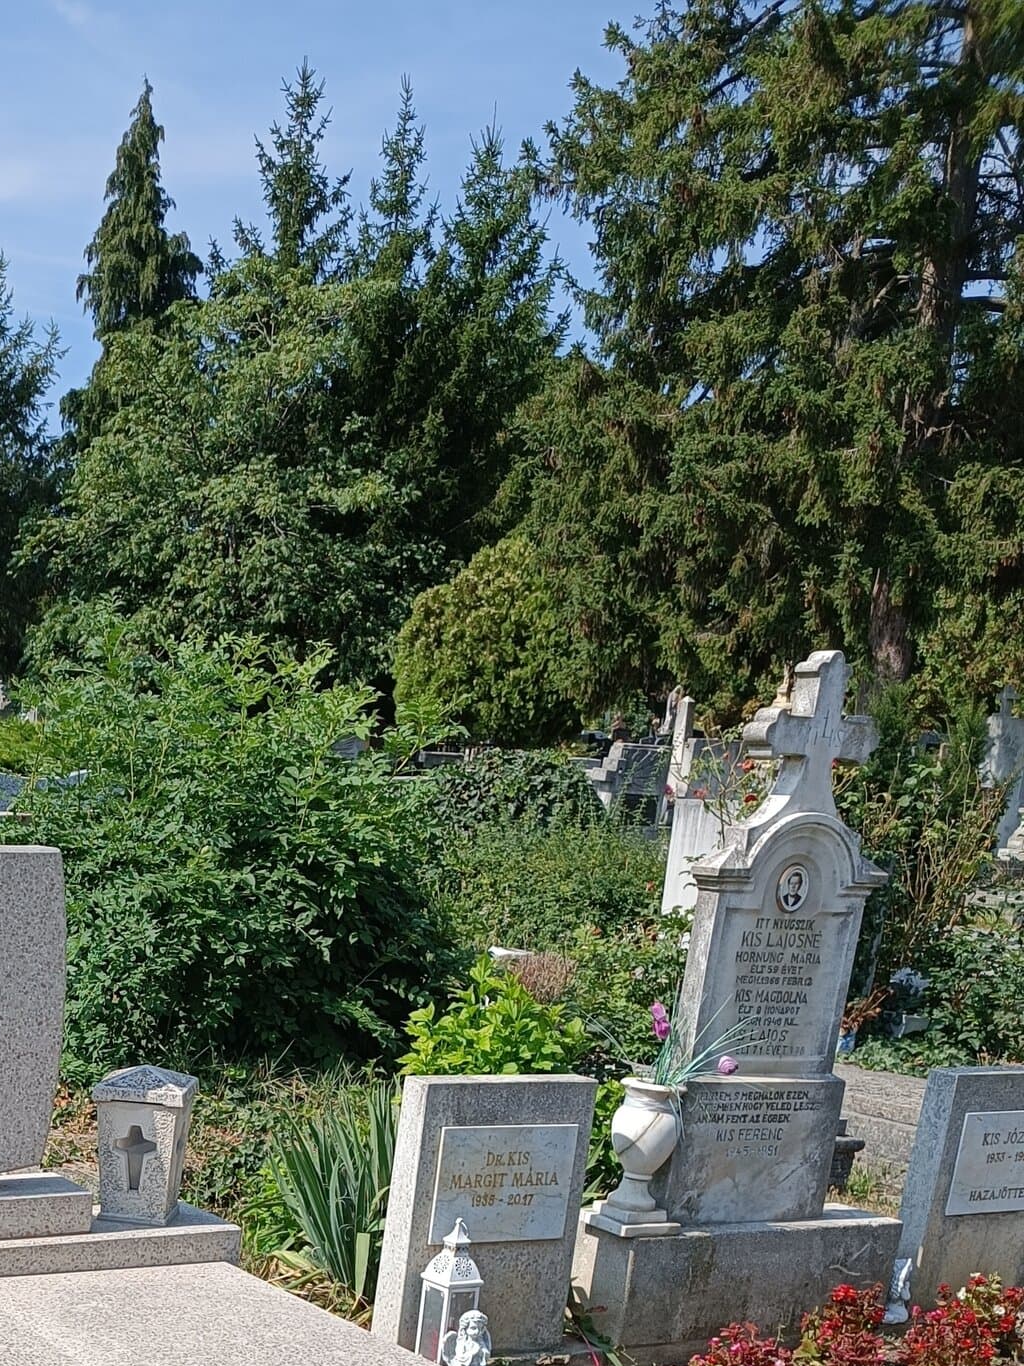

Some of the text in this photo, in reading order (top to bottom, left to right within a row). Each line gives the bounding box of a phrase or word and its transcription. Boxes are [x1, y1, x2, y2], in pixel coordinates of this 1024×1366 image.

[756, 918, 771, 928] ITT
[741, 930, 823, 949] KIS LAJOSNÉ
[736, 951, 784, 963] HORNUNG
[735, 989, 808, 1004] KIS MAGDOLNA
[765, 1101, 791, 1111] VELED
[717, 1128, 784, 1142] KIS FERENC
[982, 1132, 1001, 1146] KIS
[507, 1151, 531, 1166] KIS
[449, 1167, 559, 1190] MARGIT MÁRIA
